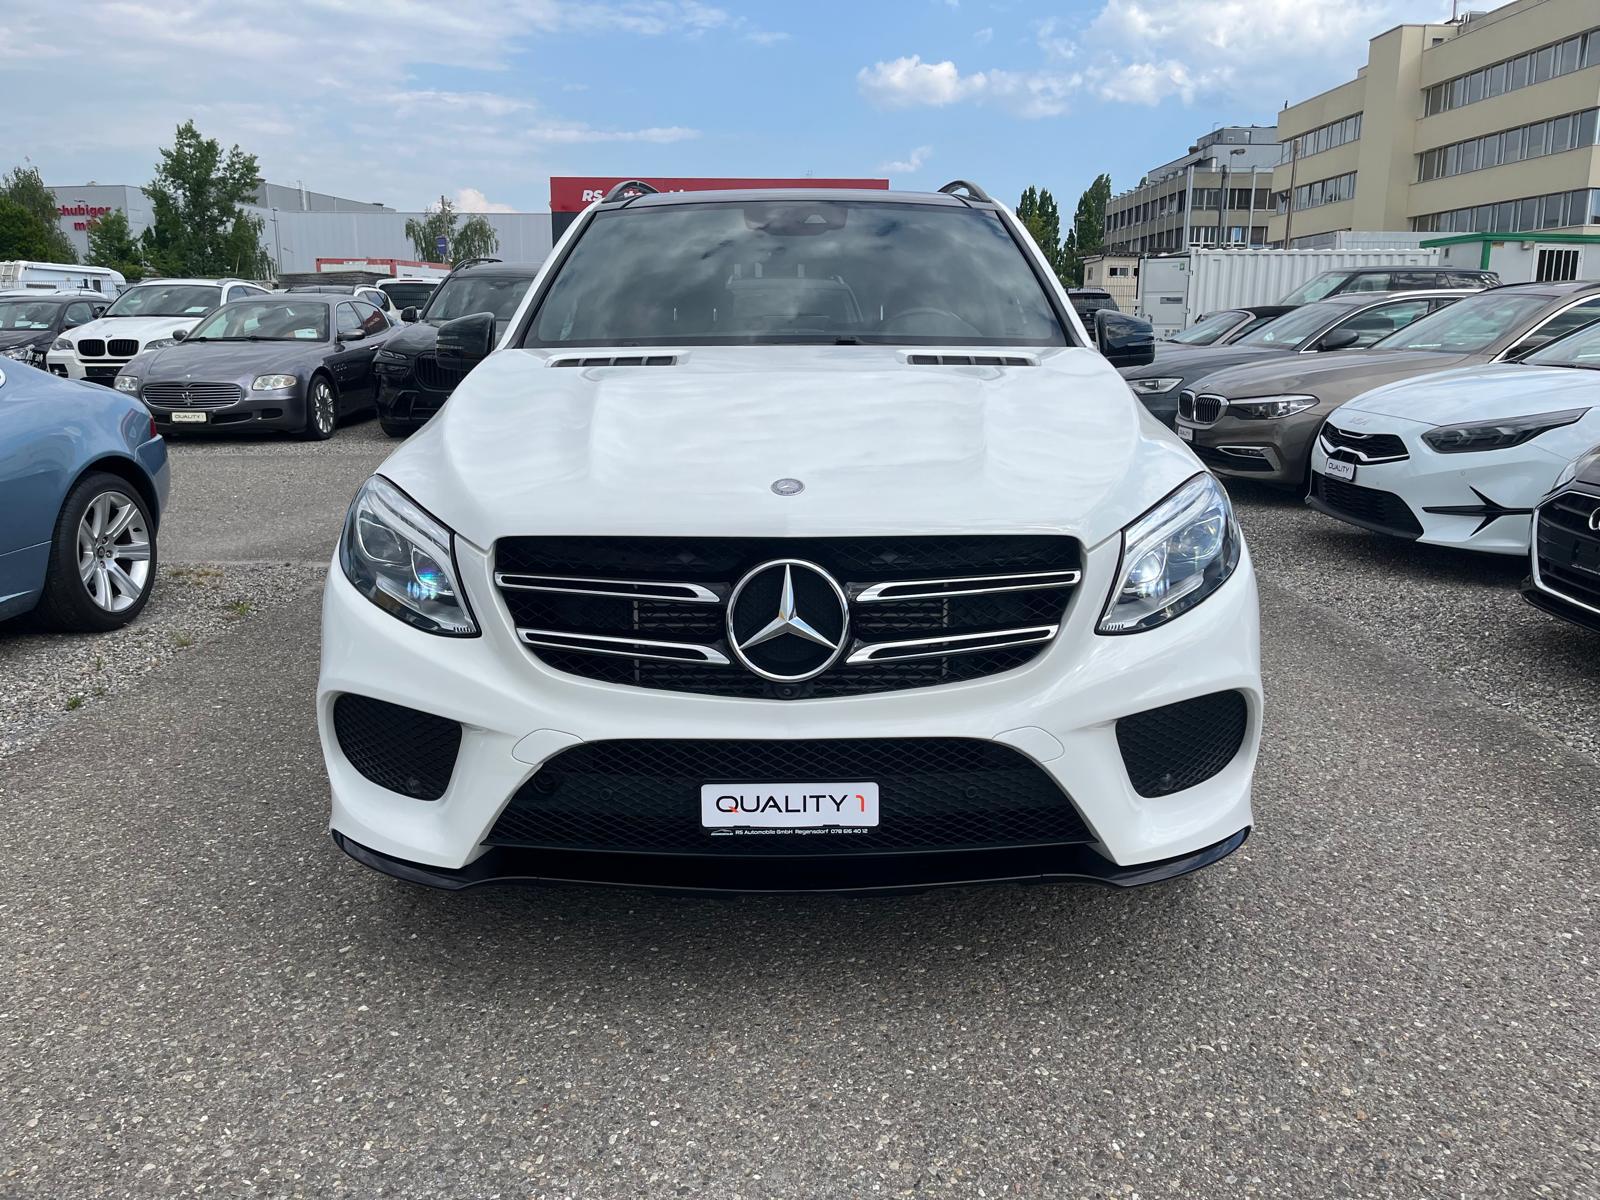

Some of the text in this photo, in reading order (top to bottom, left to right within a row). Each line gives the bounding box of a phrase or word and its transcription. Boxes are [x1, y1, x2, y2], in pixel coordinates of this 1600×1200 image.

[582, 190, 603, 201] RS
[55, 204, 111, 217] chubiger
[715, 794, 865, 813] QUALITY 1
